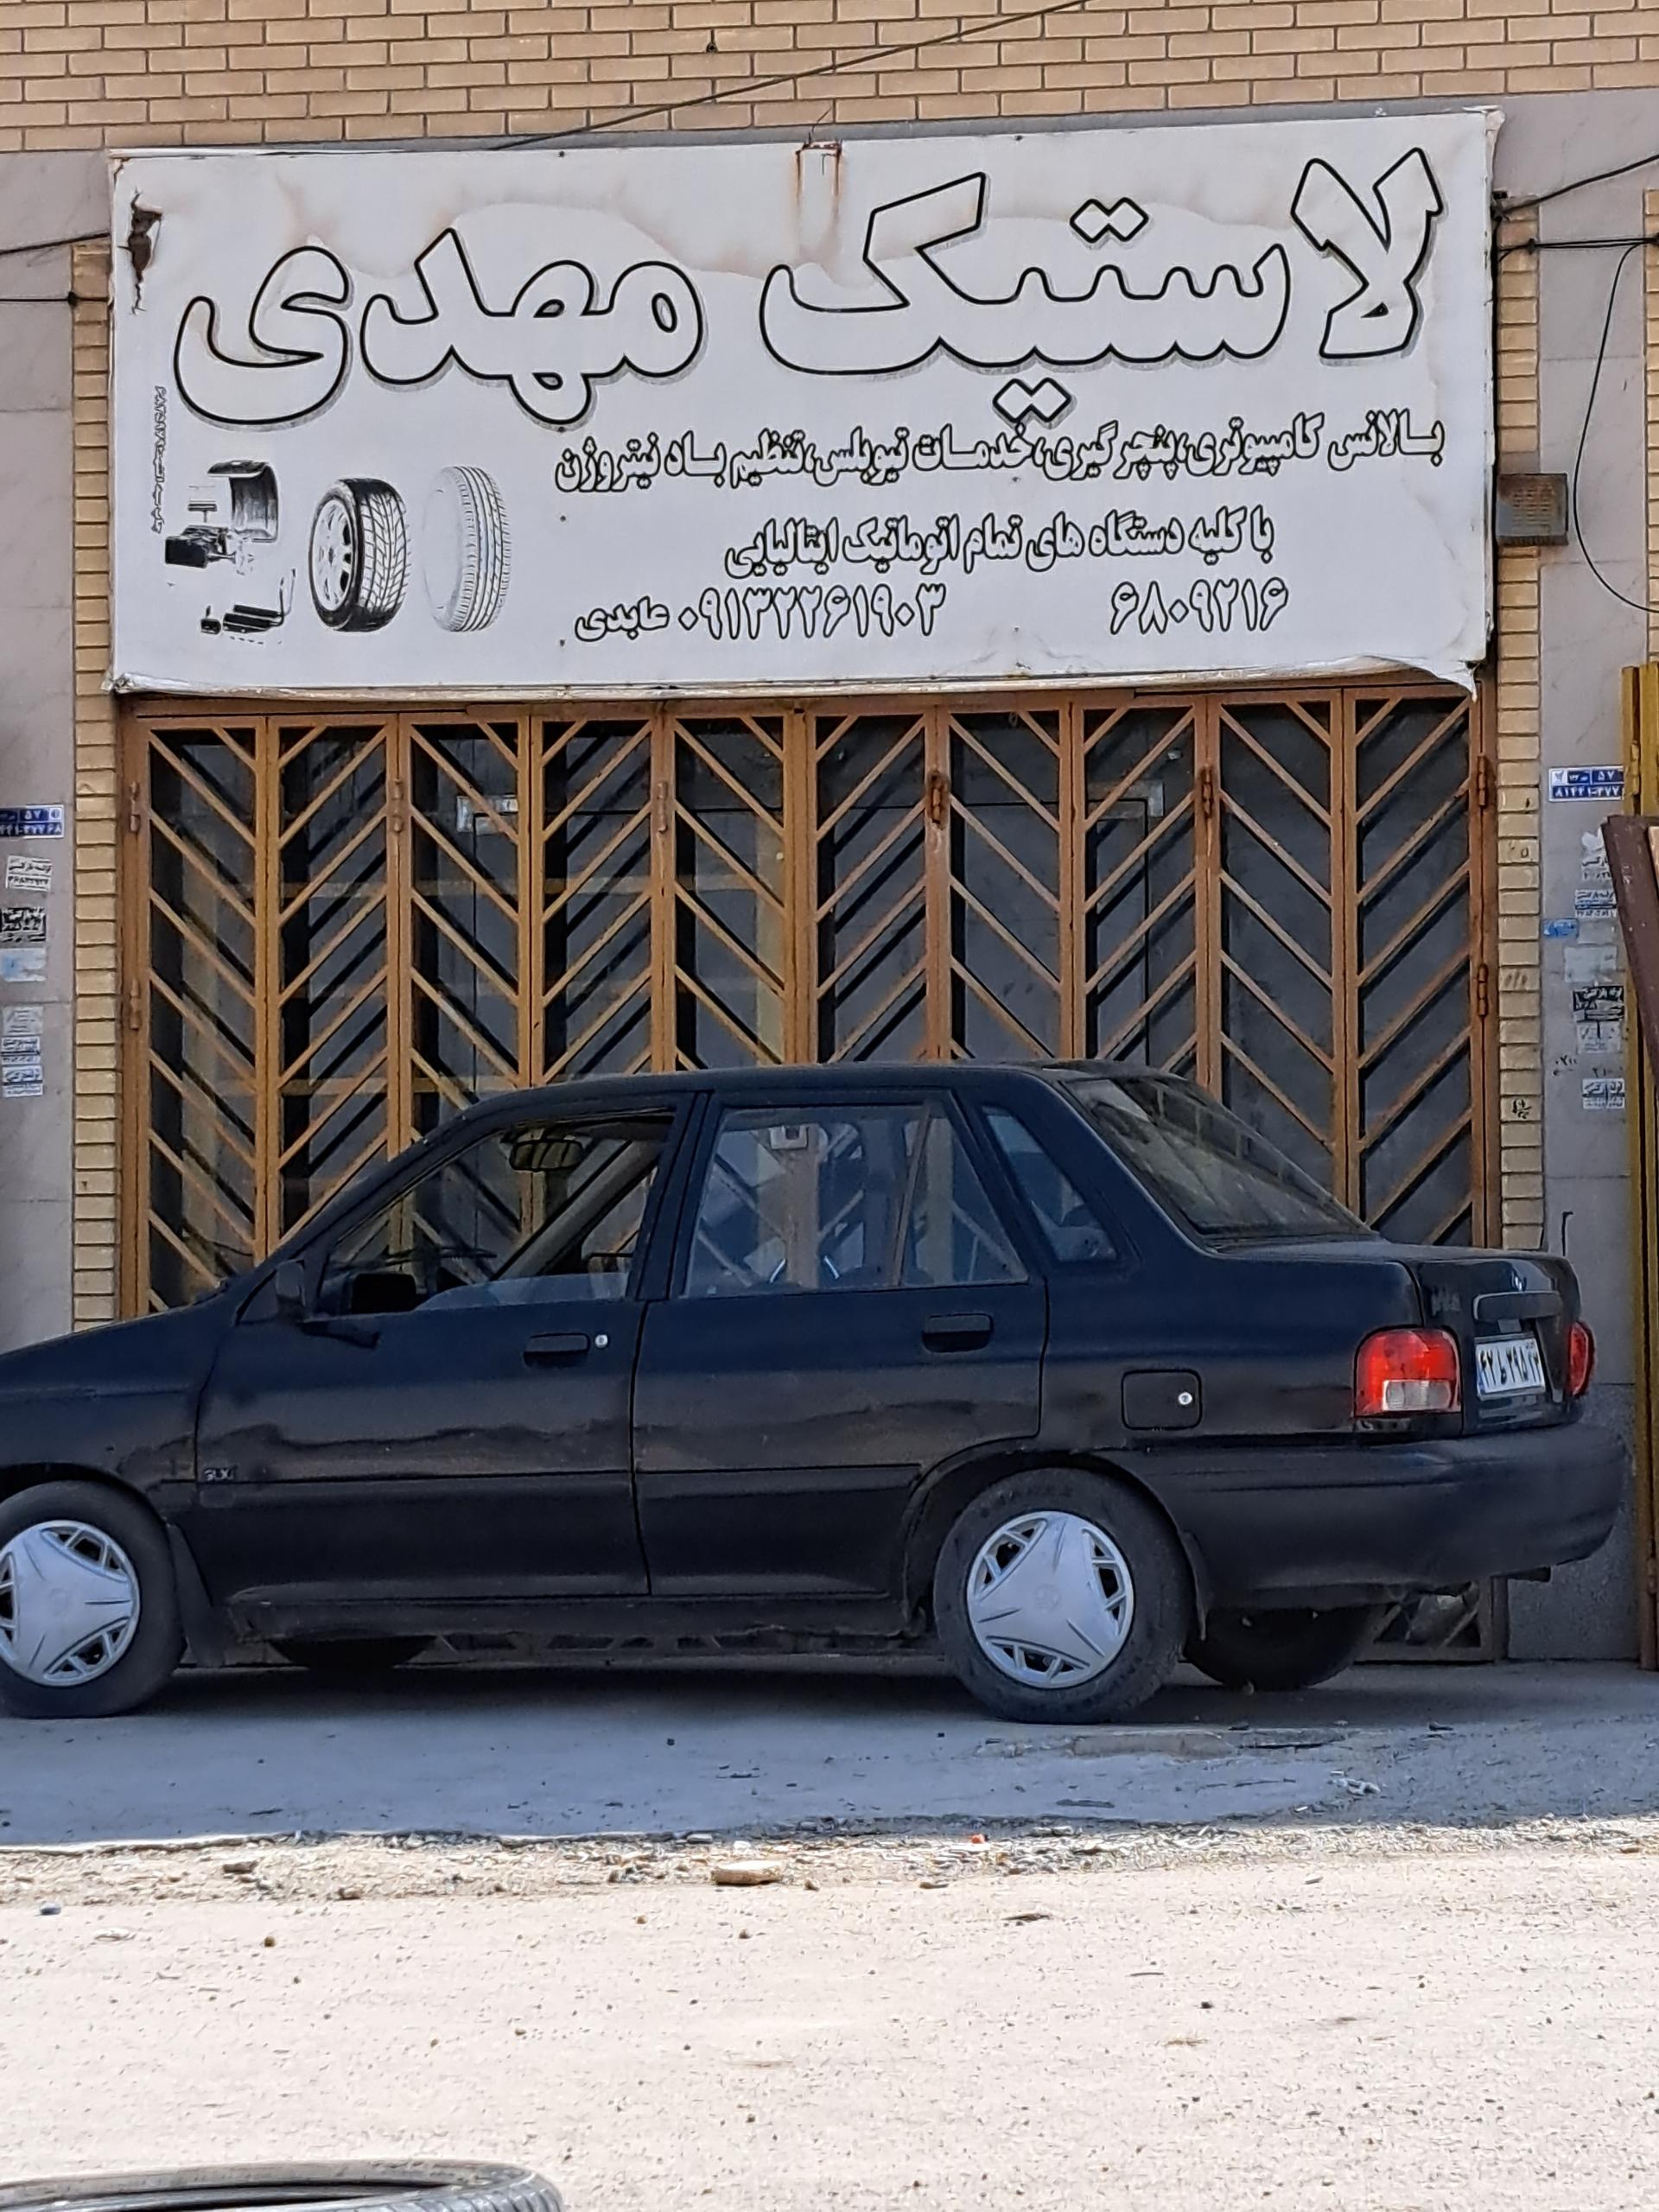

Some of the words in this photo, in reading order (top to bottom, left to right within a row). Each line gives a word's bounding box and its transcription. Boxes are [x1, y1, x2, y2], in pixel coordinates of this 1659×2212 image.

[760, 147, 1446, 423] لاستیک
[174, 226, 705, 428] مهدی
[555, 431, 661, 493] نیتروژن
[664, 429, 728, 488] باد
[730, 428, 805, 489] تنظیم
[912, 422, 1033, 470] خدمات
[1327, 408, 1445, 471] بالانس
[724, 516, 840, 580] ایتالیایی
[842, 513, 960, 575] اتوماتیک
[963, 512, 1023, 575] تمام
[1025, 510, 1086, 573] های
[1088, 509, 1185, 557] دستگاه
[1188, 505, 1248, 566] کلیه
[1250, 504, 1274, 564] با
[574, 594, 671, 641] عابدی
[677, 582, 947, 640] ۰۹۱۳۲۲۶۱۹۰۳
[1109, 576, 1290, 636] ۶۸۰۹۲۱۶
